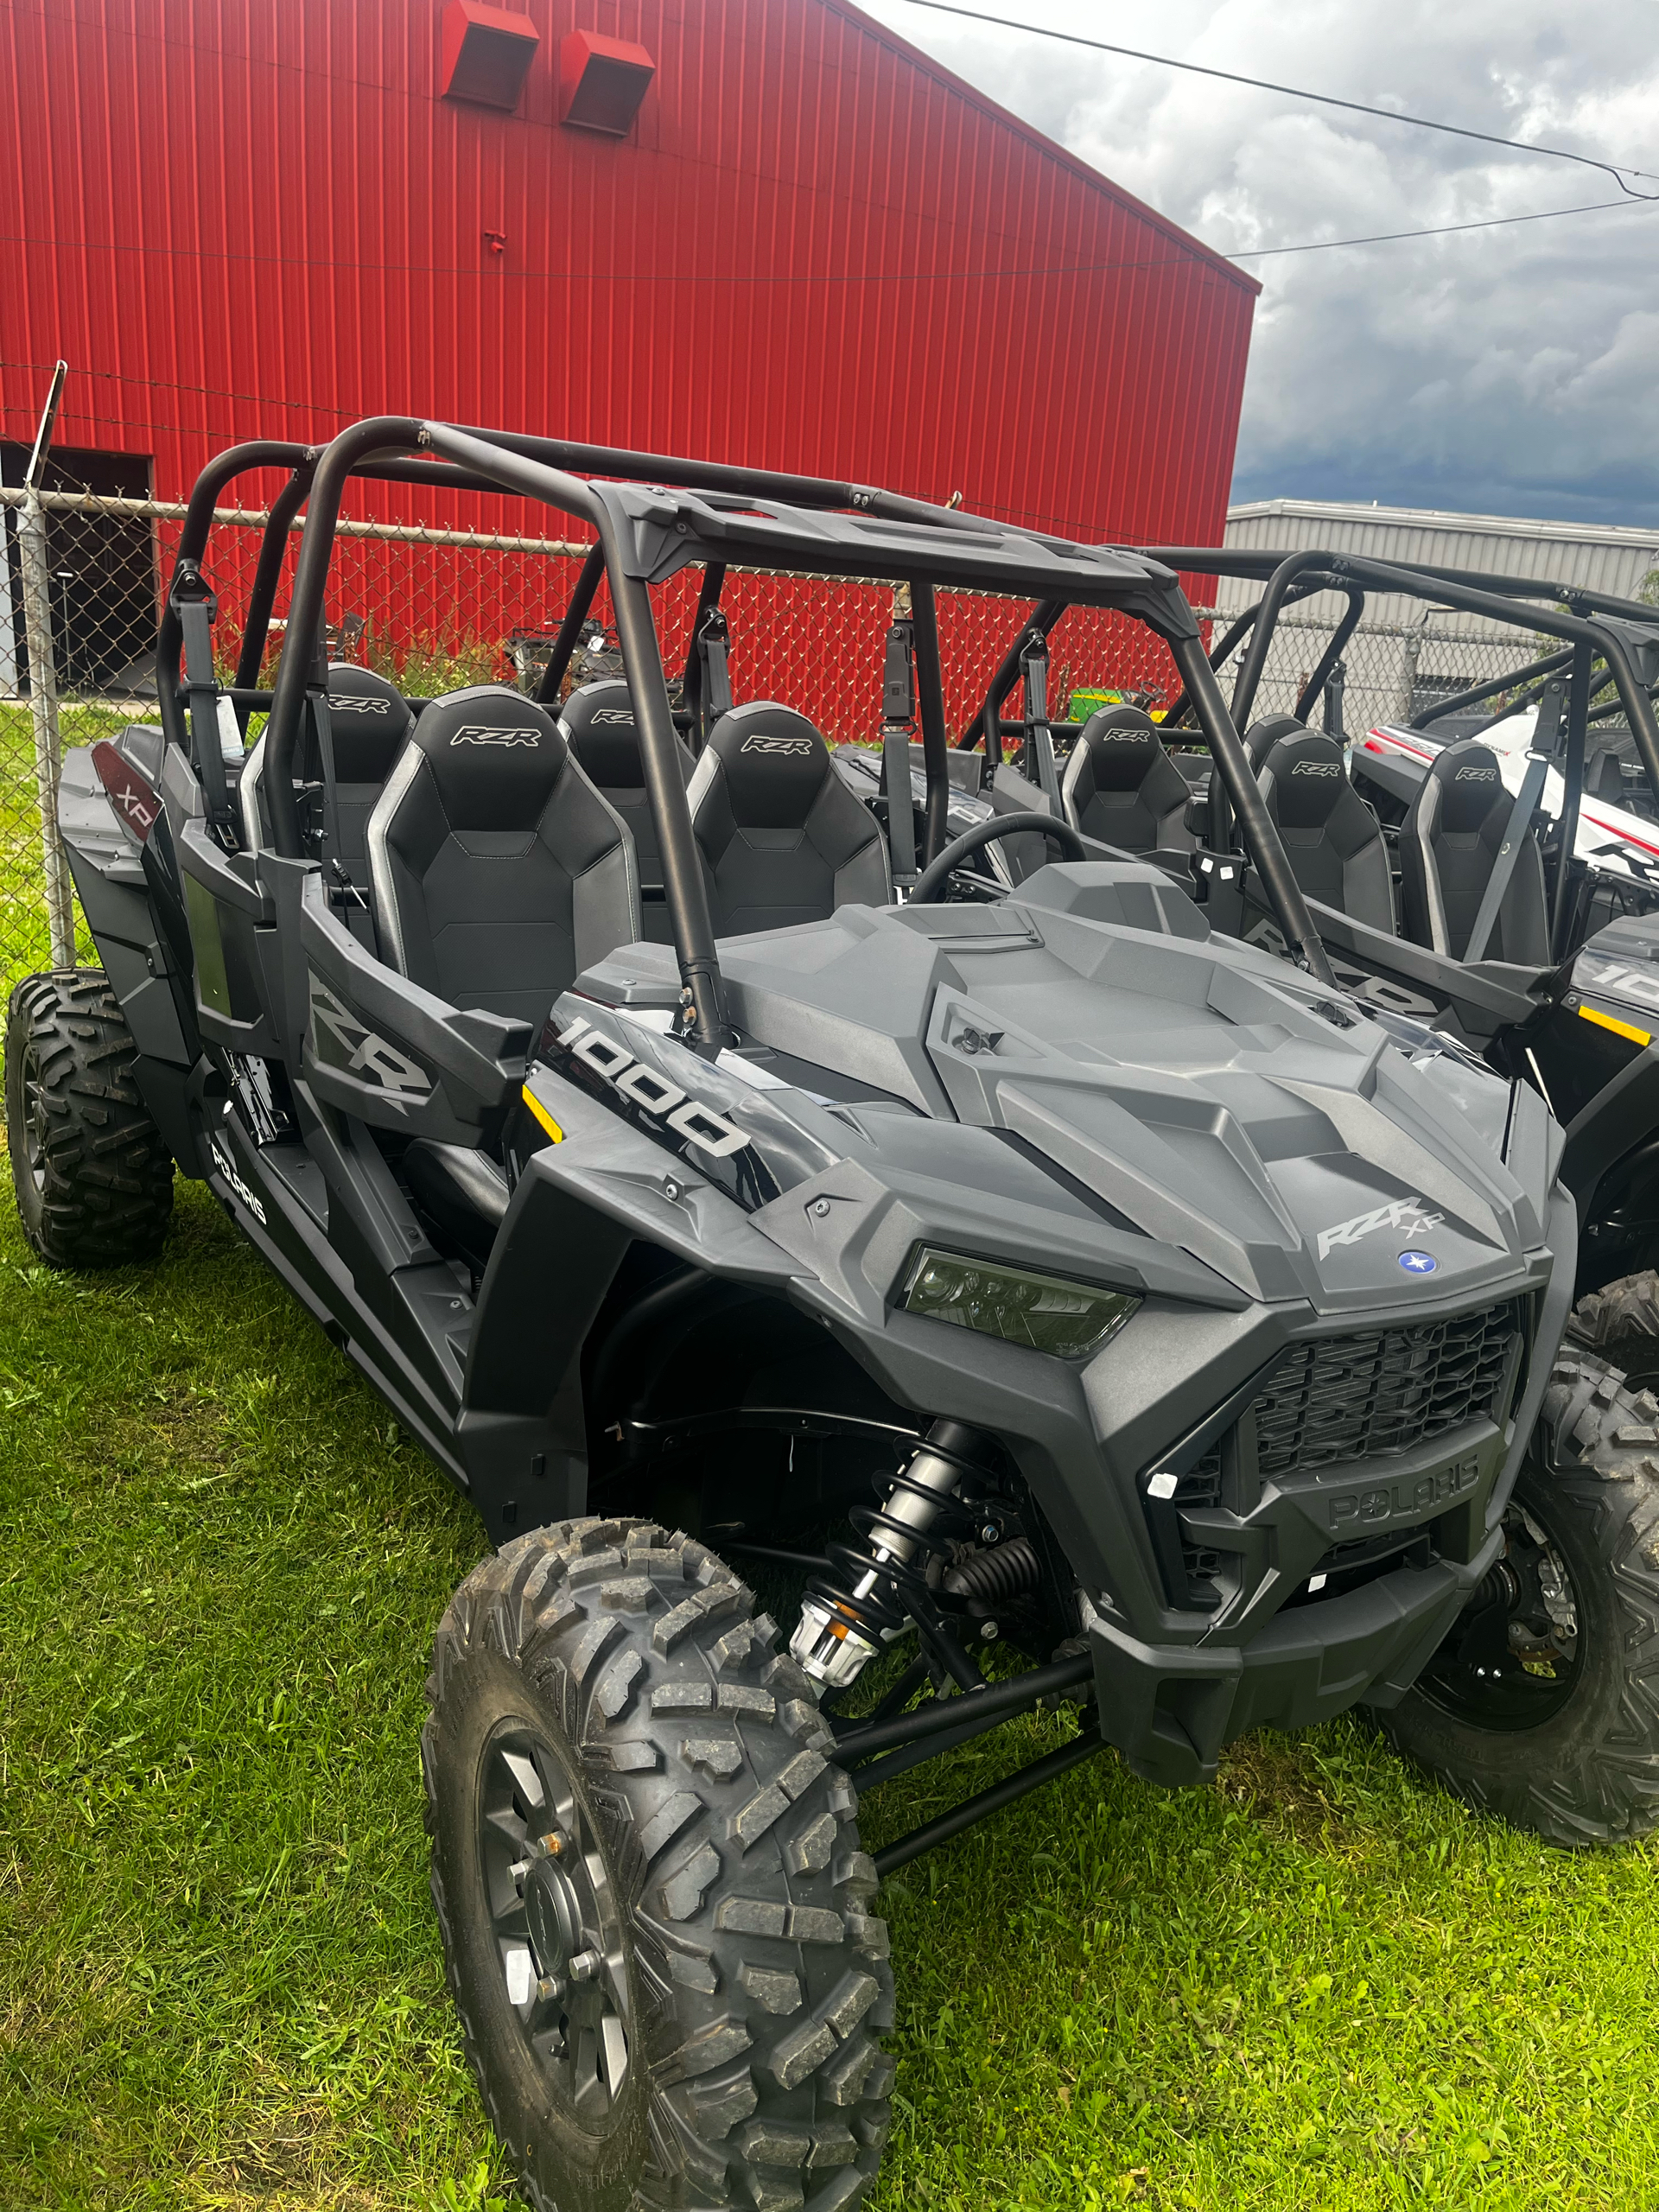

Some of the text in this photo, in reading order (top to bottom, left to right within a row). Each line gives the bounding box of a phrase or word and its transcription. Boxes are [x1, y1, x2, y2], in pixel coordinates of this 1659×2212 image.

[591, 709, 635, 726] RZ
[450, 725, 543, 747] RZR
[741, 734, 813, 755] RZR
[1103, 728, 1151, 743] RZR
[1292, 760, 1340, 778] RZR
[1455, 766, 1497, 782] RZR
[117, 783, 154, 828] XP
[556, 1015, 753, 1158] 1000
[211, 1141, 267, 1225] POLARIS
[1317, 1196, 1446, 1262] RZR XP
[1328, 1453, 1480, 1530] POLARIS
